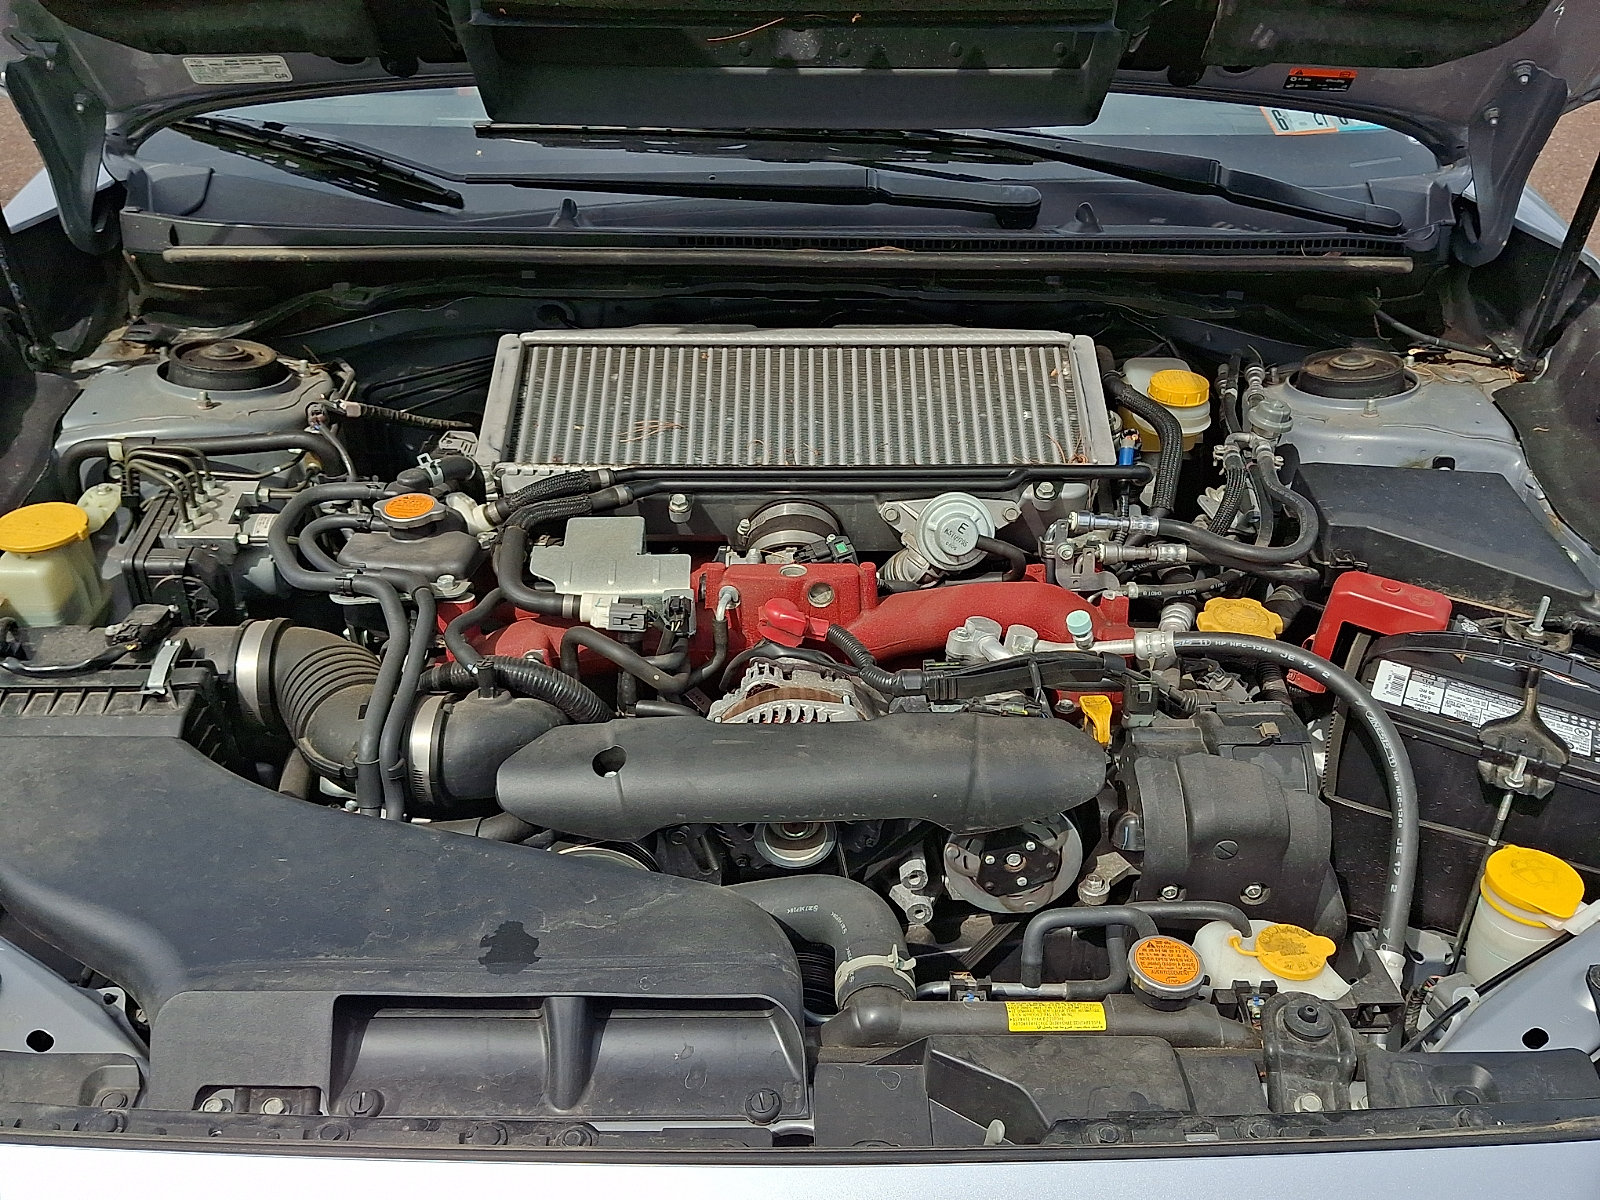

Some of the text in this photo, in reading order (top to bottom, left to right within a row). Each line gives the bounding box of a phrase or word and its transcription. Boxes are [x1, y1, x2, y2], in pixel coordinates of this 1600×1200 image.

[957, 522, 969, 535] E
[1280, 652, 1296, 662] JE
[1302, 660, 1316, 669] 17
[1321, 671, 1331, 679] 2
[1395, 838, 1404, 855] JE
[1392, 861, 1401, 877] 17
[1390, 884, 1398, 893] 2
